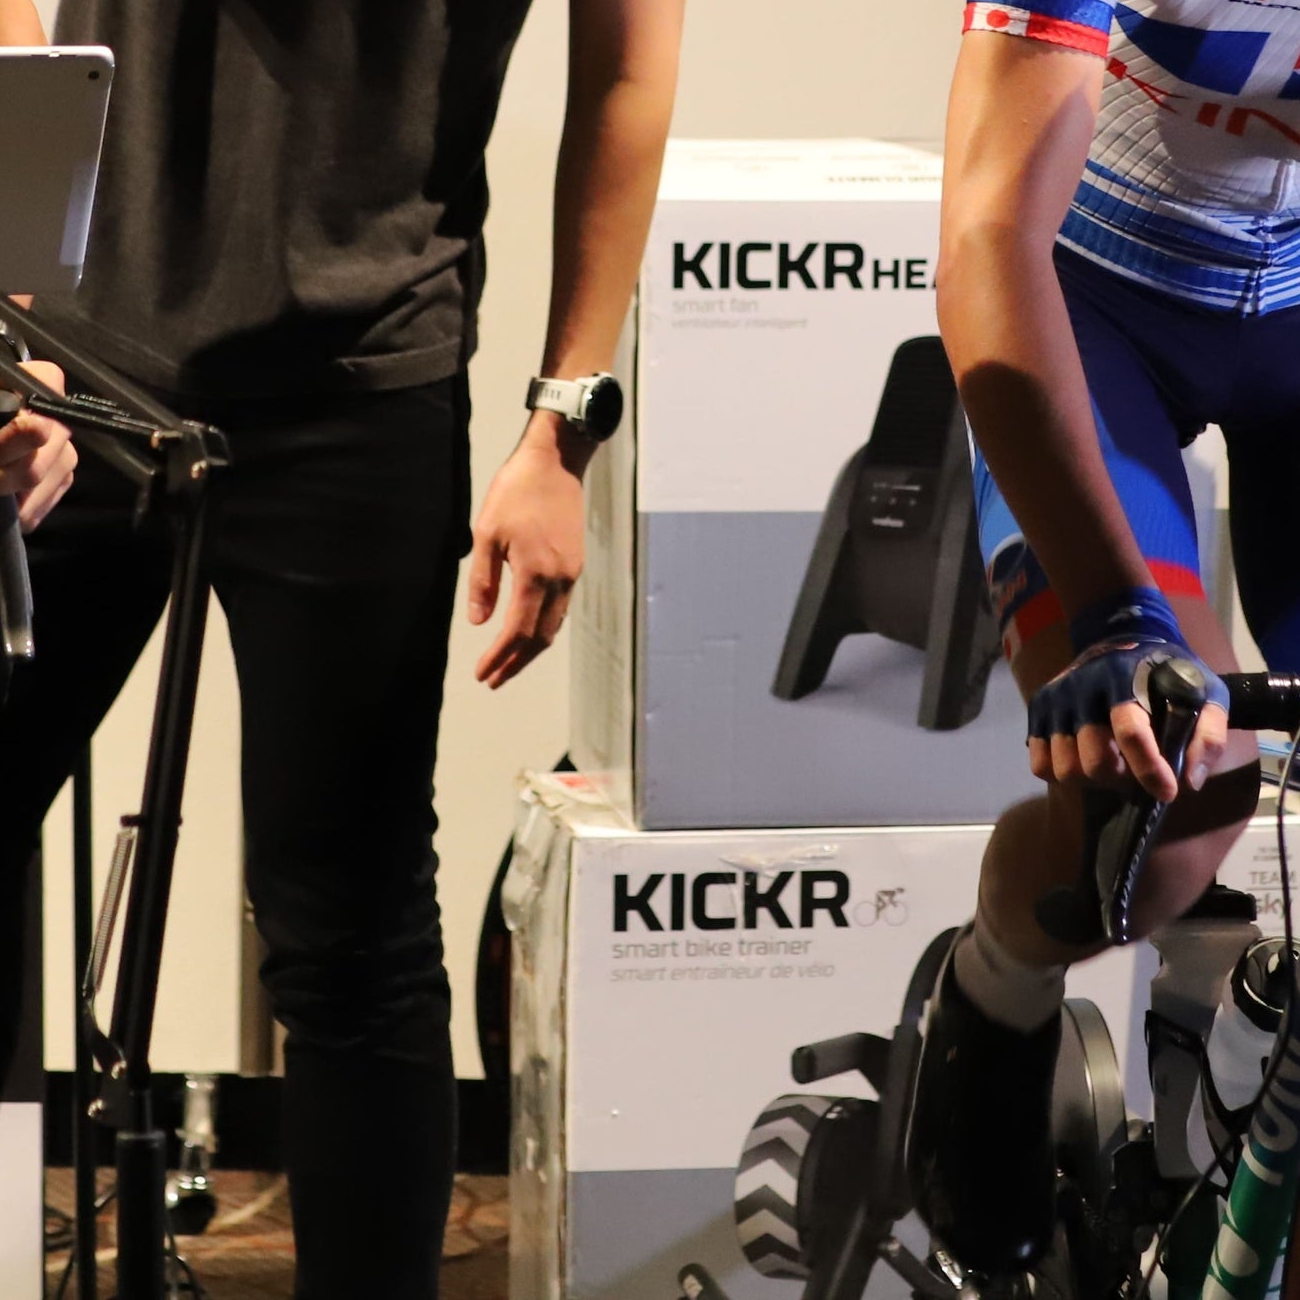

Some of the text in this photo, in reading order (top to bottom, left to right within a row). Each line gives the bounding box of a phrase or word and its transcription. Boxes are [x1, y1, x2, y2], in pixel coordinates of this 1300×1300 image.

[672, 242, 937, 290] KICKR HE
[613, 869, 850, 932] KICKR
[611, 936, 812, 959] smart bike trainer
[770, 962, 792, 979] de
